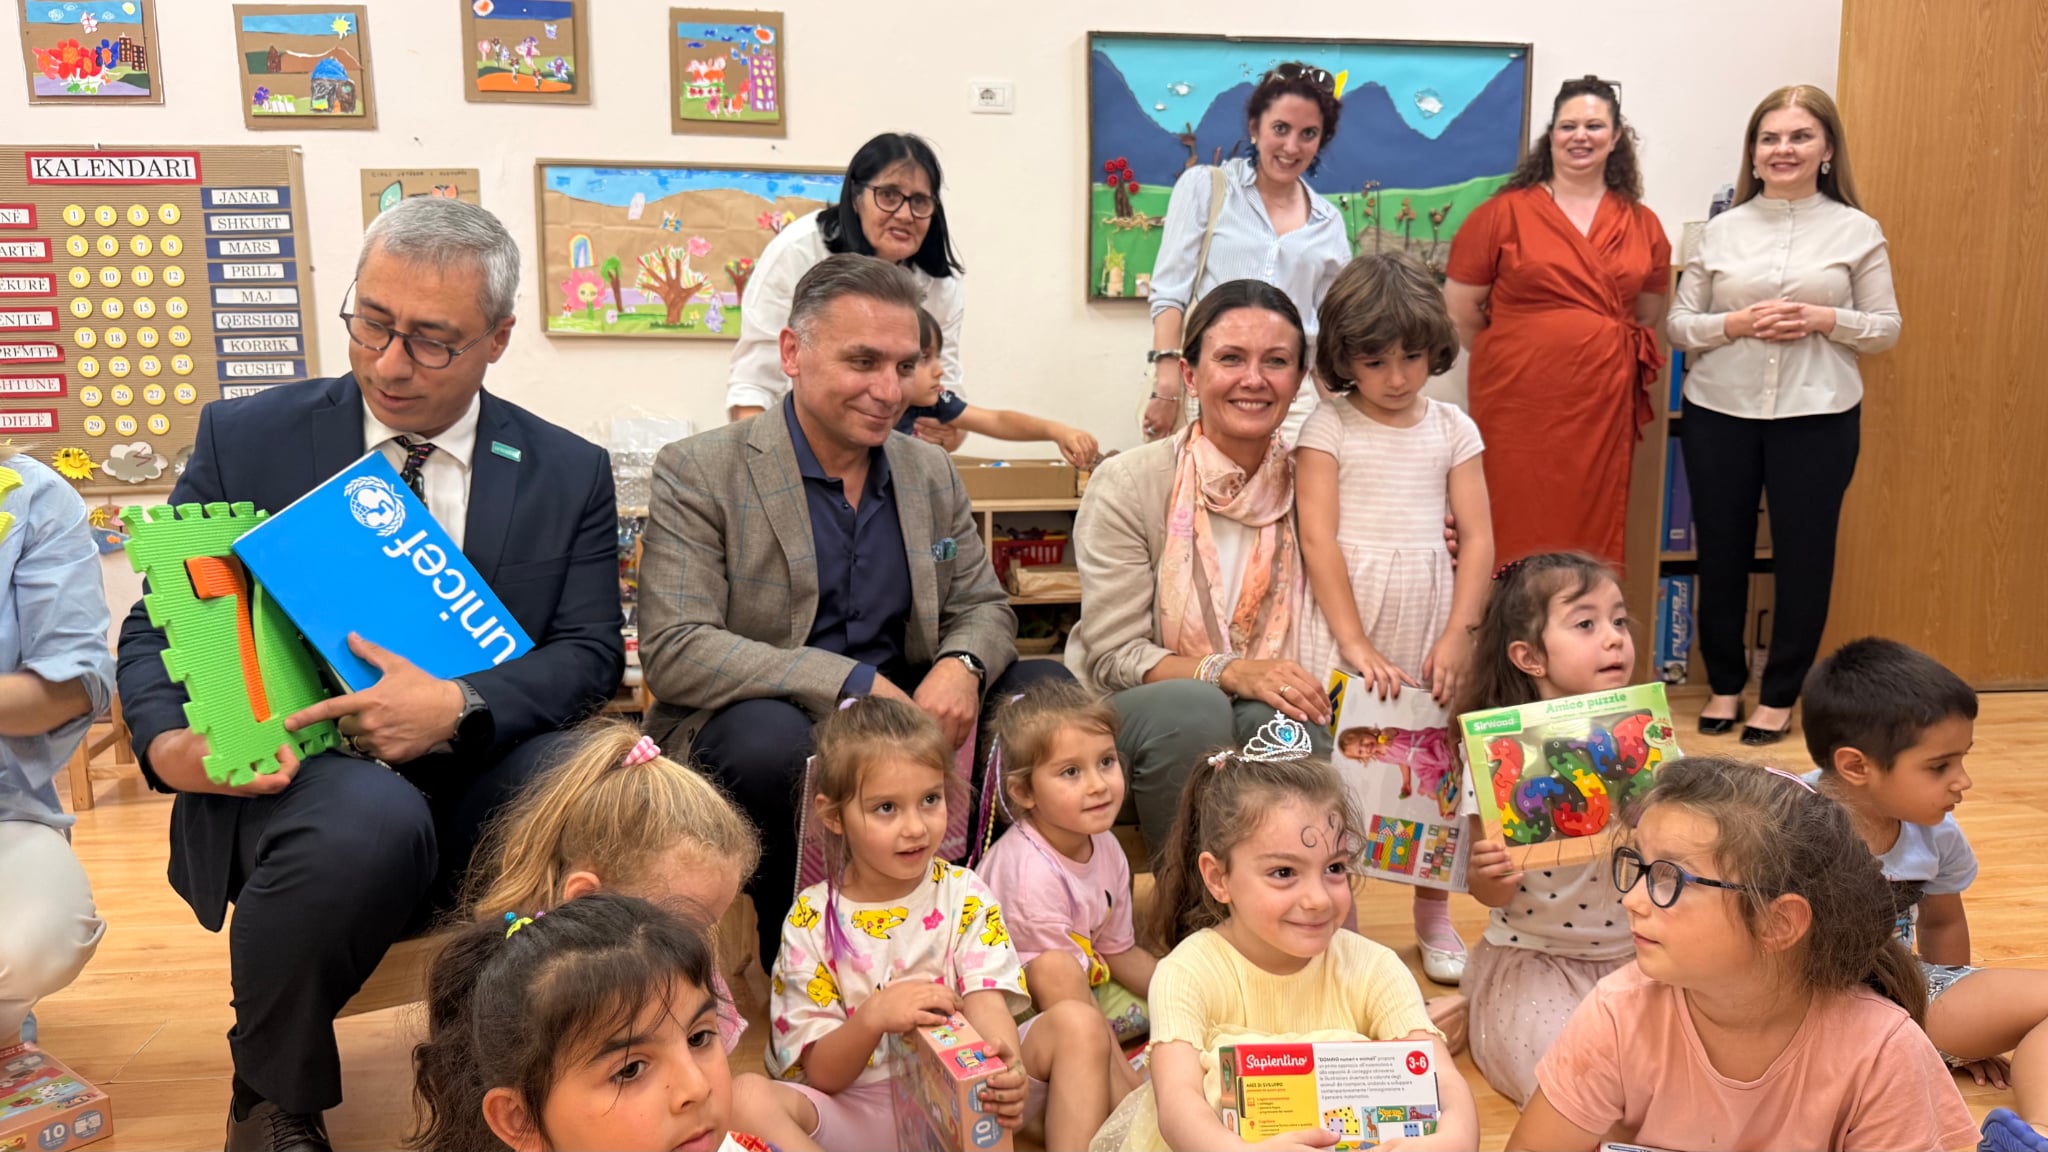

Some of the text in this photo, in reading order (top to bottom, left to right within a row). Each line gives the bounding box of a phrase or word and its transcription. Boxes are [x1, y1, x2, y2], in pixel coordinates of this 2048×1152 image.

[33, 158, 193, 178] KALENDARI
[219, 191, 270, 203] JANAR
[0, 209, 21, 223] NË
[217, 217, 281, 230] SHKURT
[0, 243, 38, 257] ARTË
[228, 241, 271, 254] MARS
[105, 273, 115, 281] 10
[138, 272, 147, 280] 11
[168, 272, 178, 280] 12
[232, 265, 276, 277] PRILL
[242, 291, 272, 302] MAJ
[77, 303, 182, 312] 13 14 15 16
[221, 314, 294, 328] QERSHOR
[81, 332, 185, 342] 17 18 19 20
[230, 340, 290, 351] KORRIK
[84, 360, 188, 371] 21 22 23 24
[233, 363, 286, 375] GUSHT
[86, 390, 191, 400] 25 26 27 28
[230, 388, 266, 399] SHT
[89, 420, 164, 429] 29 30 31
[382, 530, 516, 665] unicef
[1545, 693, 1627, 714] Amico puzzle
[1473, 717, 1515, 731] SirWood
[1246, 1054, 1307, 1071] Sapientino
[1408, 1056, 1427, 1069] 3-6
[43, 1124, 65, 1141] 10
[976, 1120, 991, 1144] 10
